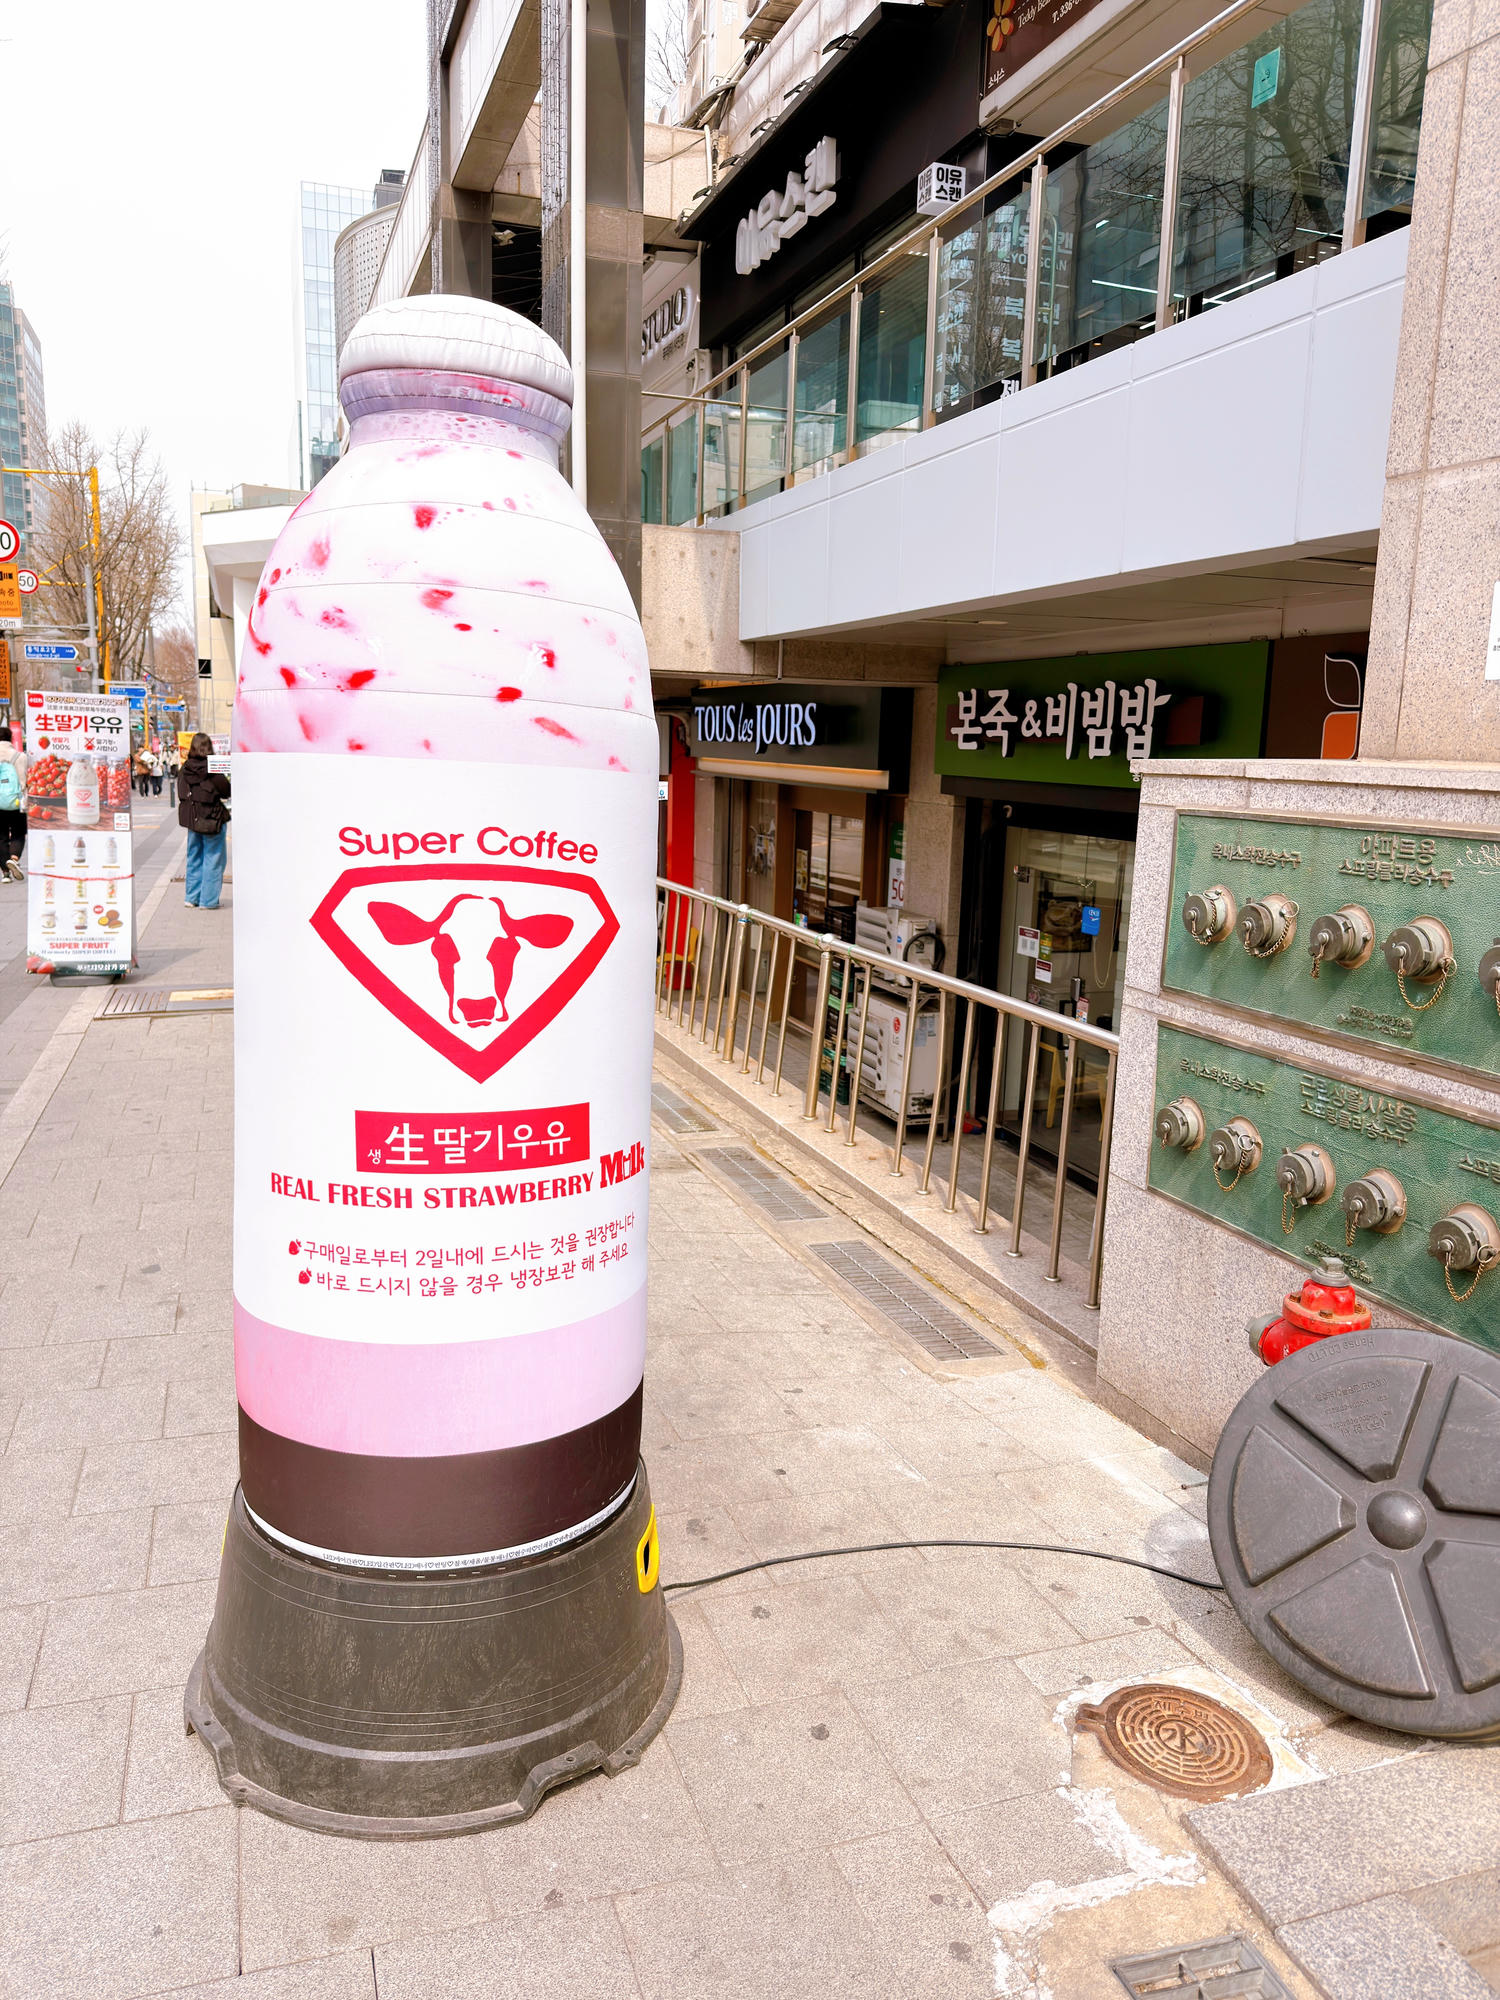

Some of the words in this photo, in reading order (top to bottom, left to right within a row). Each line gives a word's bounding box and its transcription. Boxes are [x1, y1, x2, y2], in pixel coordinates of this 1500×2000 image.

[919, 168, 933, 188] 이유
[936, 166, 963, 185] 이유
[935, 186, 962, 204] 스캔
[19, 576, 35, 588] 50
[695, 704, 735, 743] TOUS
[737, 704, 754, 743] les
[755, 702, 817, 754] JOURS
[338, 826, 465, 861] Super
[476, 826, 599, 864] Coffee
[1212, 841, 1302, 869] 옥내소화전송수구
[1360, 834, 1437, 865] 아파트용
[1179, 1058, 1266, 1097] 옥내소화전송수구
[367, 1149, 382, 1165] 생
[270, 1171, 321, 1202] REAL
[327, 1182, 413, 1209] FRESH
[423, 1170, 594, 1209] STRAWBERRY
[303, 1241, 407, 1268] 구매일로부터
[415, 1246, 484, 1269] 2일내에
[491, 1240, 545, 1263] 드시는
[550, 1232, 580, 1256] 것을
[584, 1213, 636, 1248] 권장합니다
[316, 1271, 350, 1292] 바로
[356, 1276, 411, 1297] 드시지
[419, 1276, 458, 1297] 않을
[466, 1273, 504, 1295] 경우
[510, 1260, 577, 1289] 냉장보관
[580, 1254, 595, 1273] 해
[599, 1239, 629, 1267] 주세요
